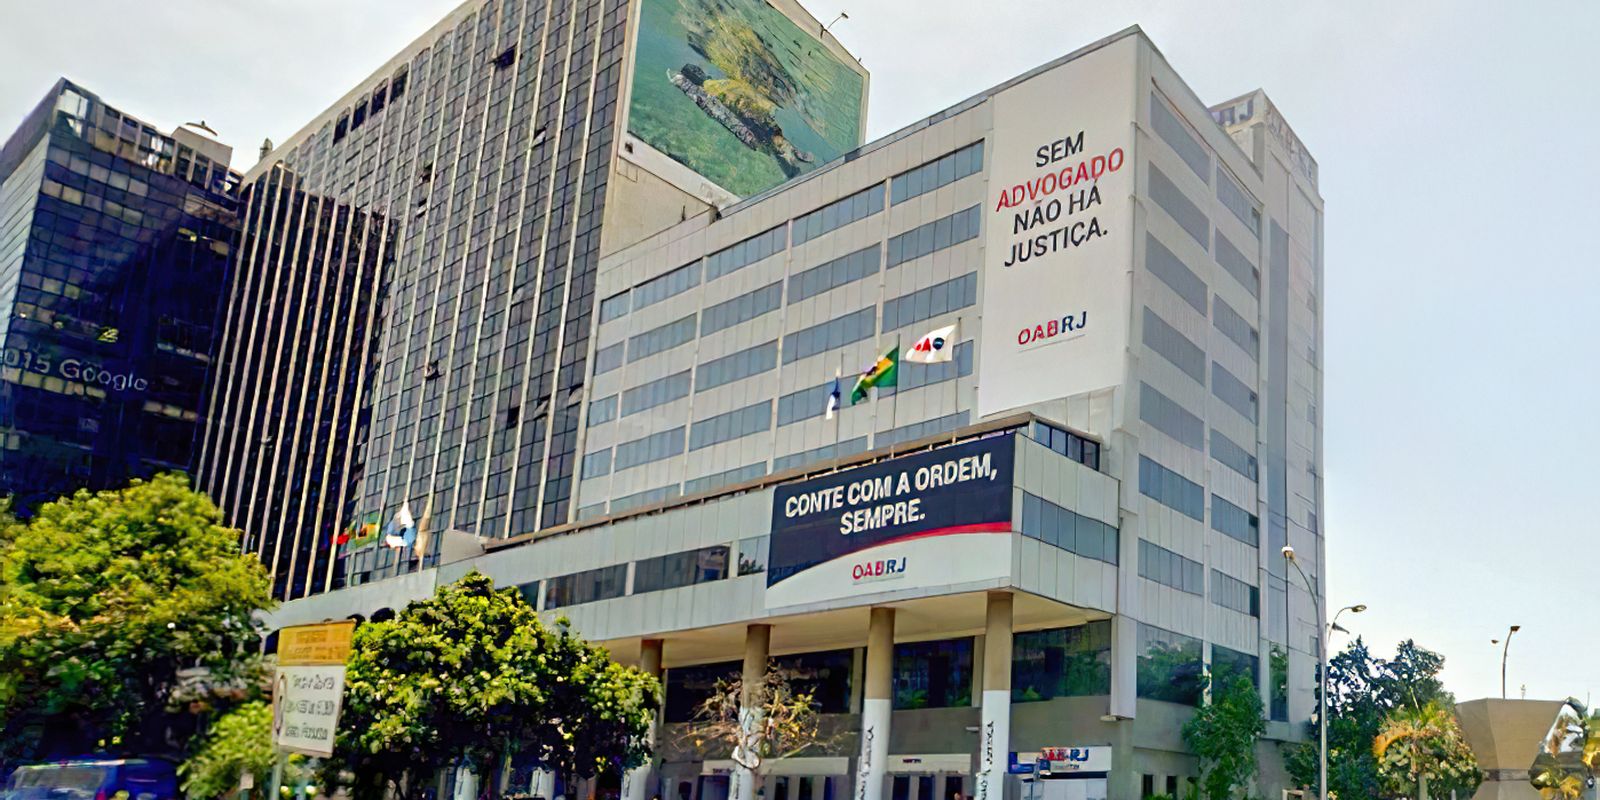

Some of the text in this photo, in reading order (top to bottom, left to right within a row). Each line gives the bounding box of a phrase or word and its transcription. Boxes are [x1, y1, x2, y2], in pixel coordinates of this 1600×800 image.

[1036, 130, 1085, 168] SEM
[995, 147, 1124, 212] ADVOGADO
[1013, 178, 1102, 235] NÃO HÁ
[1004, 216, 1108, 267] JUSTIÇA.
[1017, 310, 1087, 345] OABRJ
[785, 452, 998, 519] CONTE COM A ORDEM,
[839, 498, 926, 535] SEMPRE.
